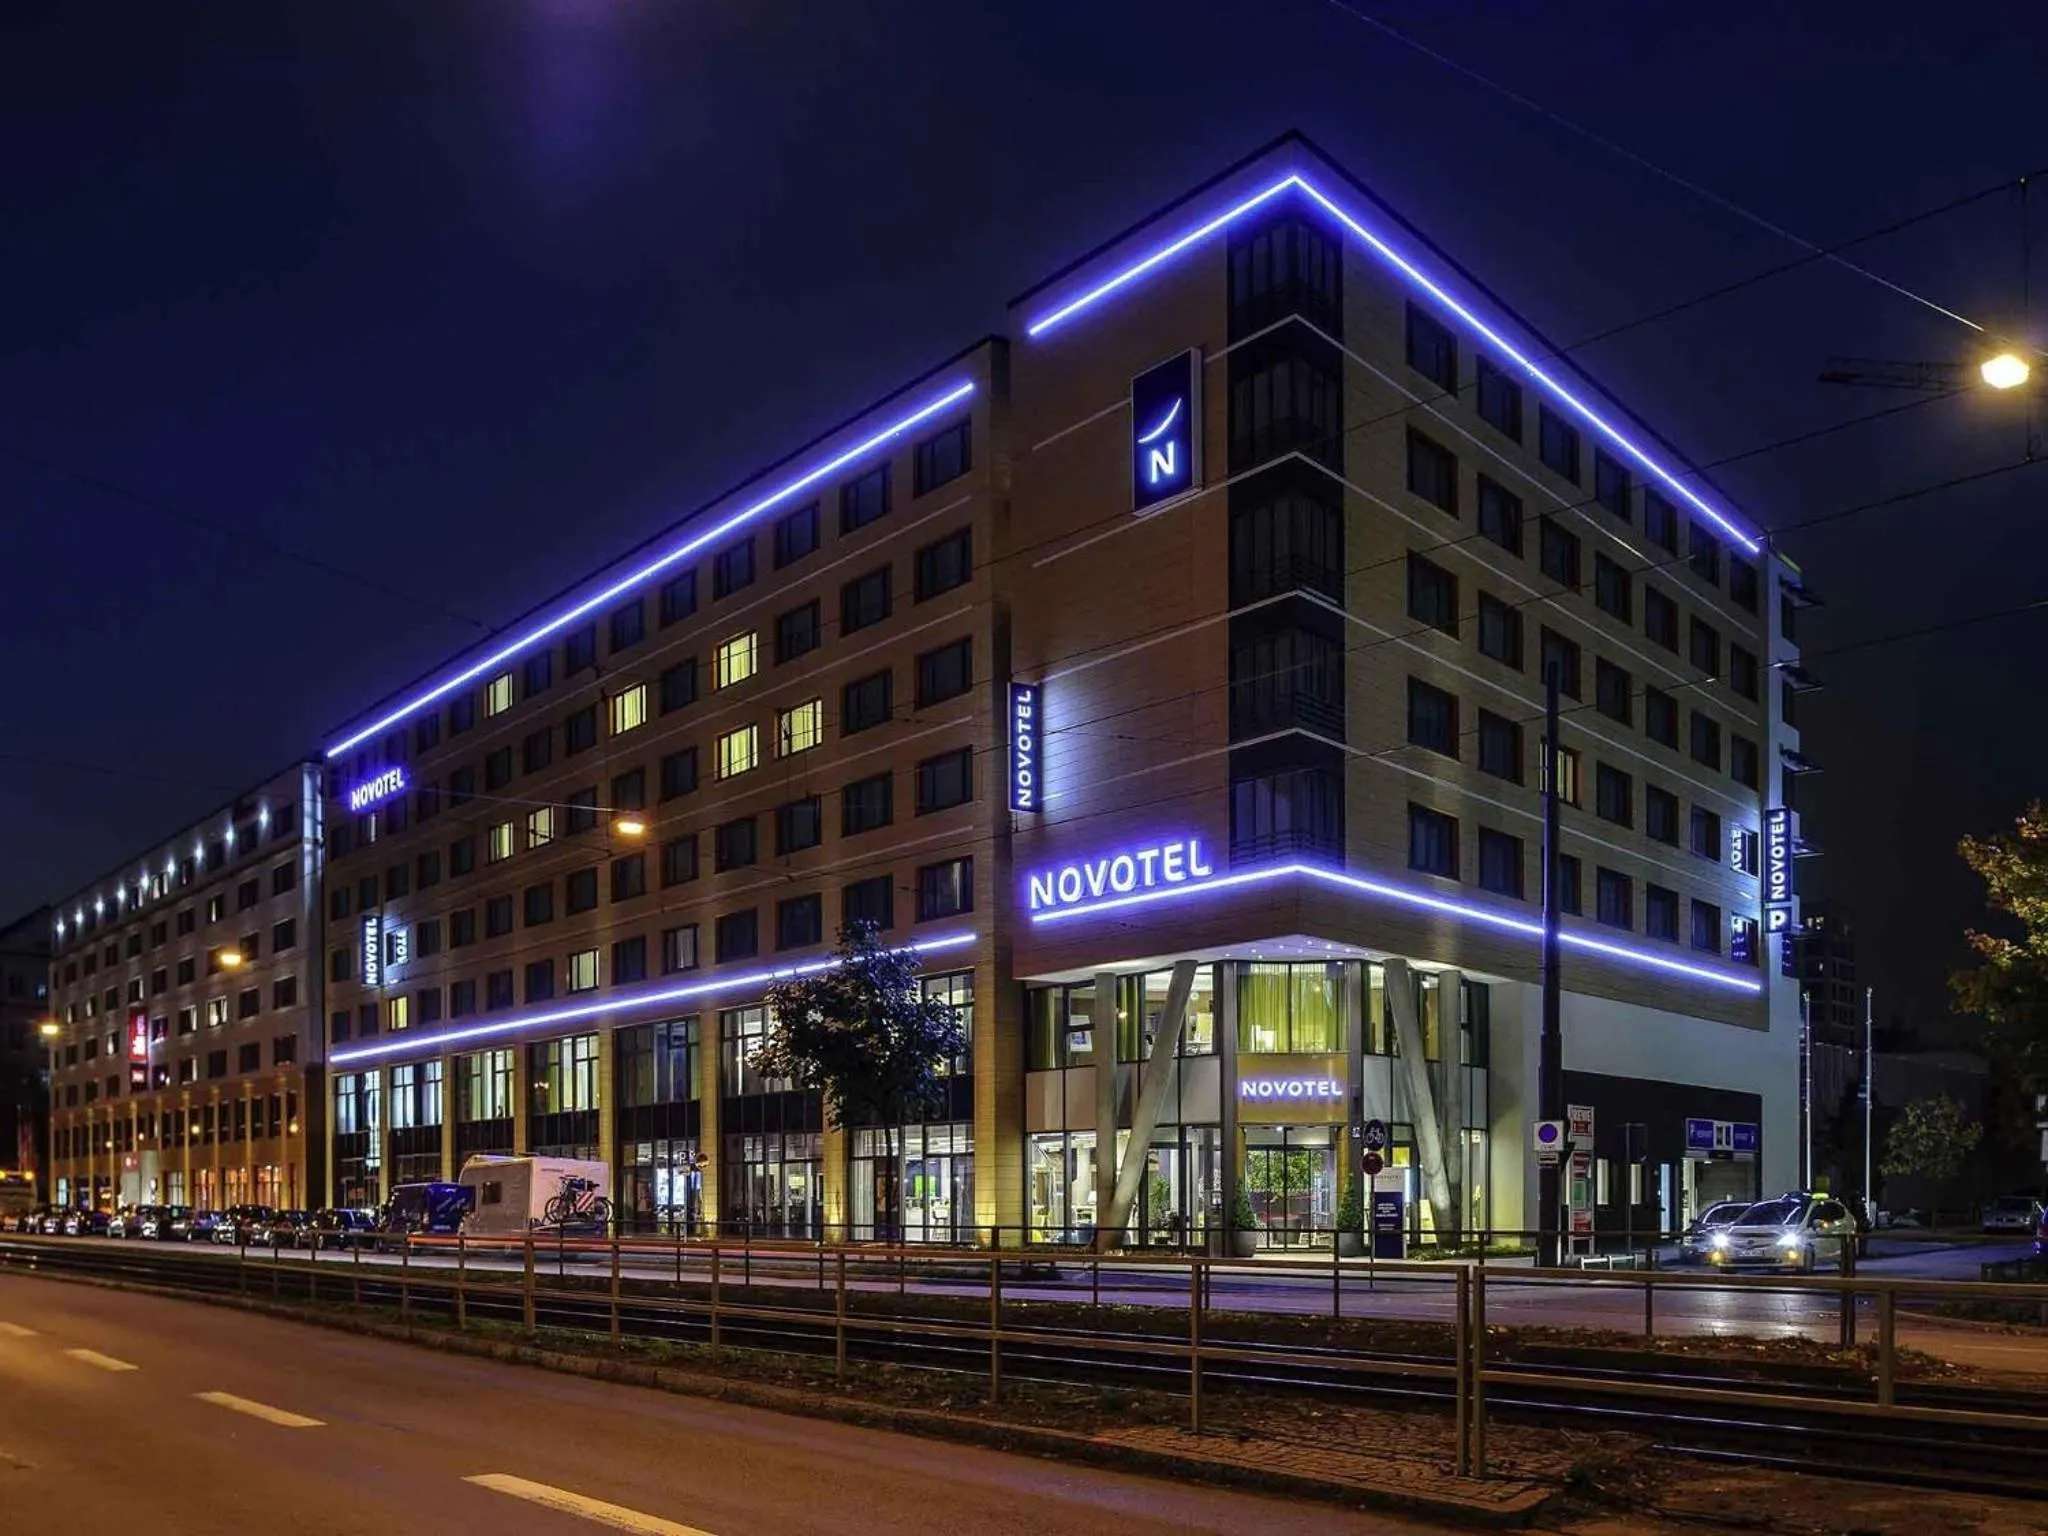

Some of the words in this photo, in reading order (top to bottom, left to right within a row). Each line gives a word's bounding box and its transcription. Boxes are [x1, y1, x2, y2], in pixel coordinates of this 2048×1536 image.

[1151, 440, 1175, 484] N
[1017, 689, 1033, 807] NOVOTEL
[351, 767, 405, 811] NOVOTEL
[1030, 839, 1212, 909] NOVOTEL
[1770, 811, 1786, 900] NOVOTEL
[1769, 909, 1788, 931] P
[365, 917, 378, 984] NOVOTEL
[1241, 1080, 1344, 1097] NOVOTEL
